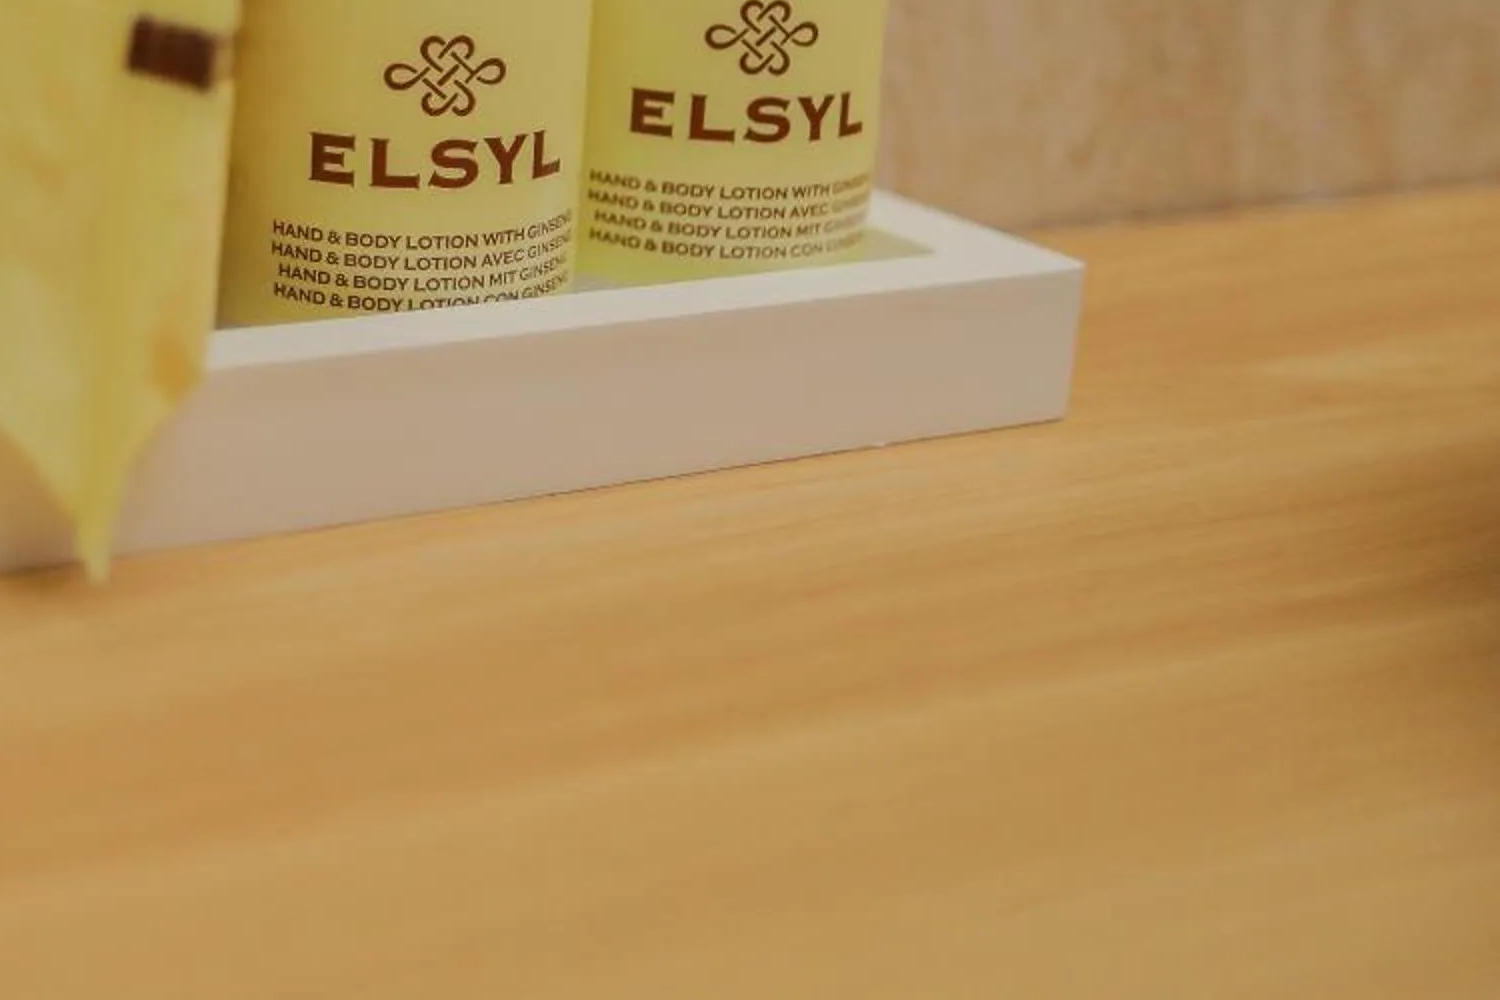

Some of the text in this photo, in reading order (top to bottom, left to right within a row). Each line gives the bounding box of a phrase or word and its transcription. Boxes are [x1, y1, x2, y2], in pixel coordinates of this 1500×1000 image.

[630, 87, 863, 143] ELSYL
[308, 130, 560, 189] ELSYL
[589, 168, 641, 190] HAND
[645, 179, 657, 193] &
[662, 181, 716, 198] BODY
[720, 186, 788, 200] LOTION
[791, 183, 830, 198] WITH
[587, 187, 639, 210] HAND
[642, 199, 655, 212] &
[660, 201, 713, 217] BODY
[717, 206, 786, 219] LOTION
[789, 202, 828, 218] AVEC
[273, 219, 323, 242] HAND
[328, 230, 341, 245] &
[345, 232, 402, 249] BODY
[406, 234, 479, 250] LOTION
[482, 227, 525, 246] WITH
[594, 208, 821, 239] HAND & BODY LOTION MIT
[271, 240, 323, 263] HAND
[326, 251, 339, 265] &
[344, 253, 400, 270] BODY
[404, 256, 476, 271] LOTION
[481, 249, 525, 268] AVEC
[589, 226, 641, 249] HAND
[644, 238, 657, 252] &
[662, 240, 716, 257] BODY
[720, 245, 787, 259] LOTION
[790, 242, 823, 258] CON
[278, 263, 331, 285] HAND
[335, 273, 349, 287] &
[353, 275, 409, 291] BODY
[414, 275, 485, 291] LOTION
[489, 270, 517, 287] MIT
[274, 283, 326, 305] HAND
[329, 293, 343, 308] &
[347, 295, 404, 312] BODY
